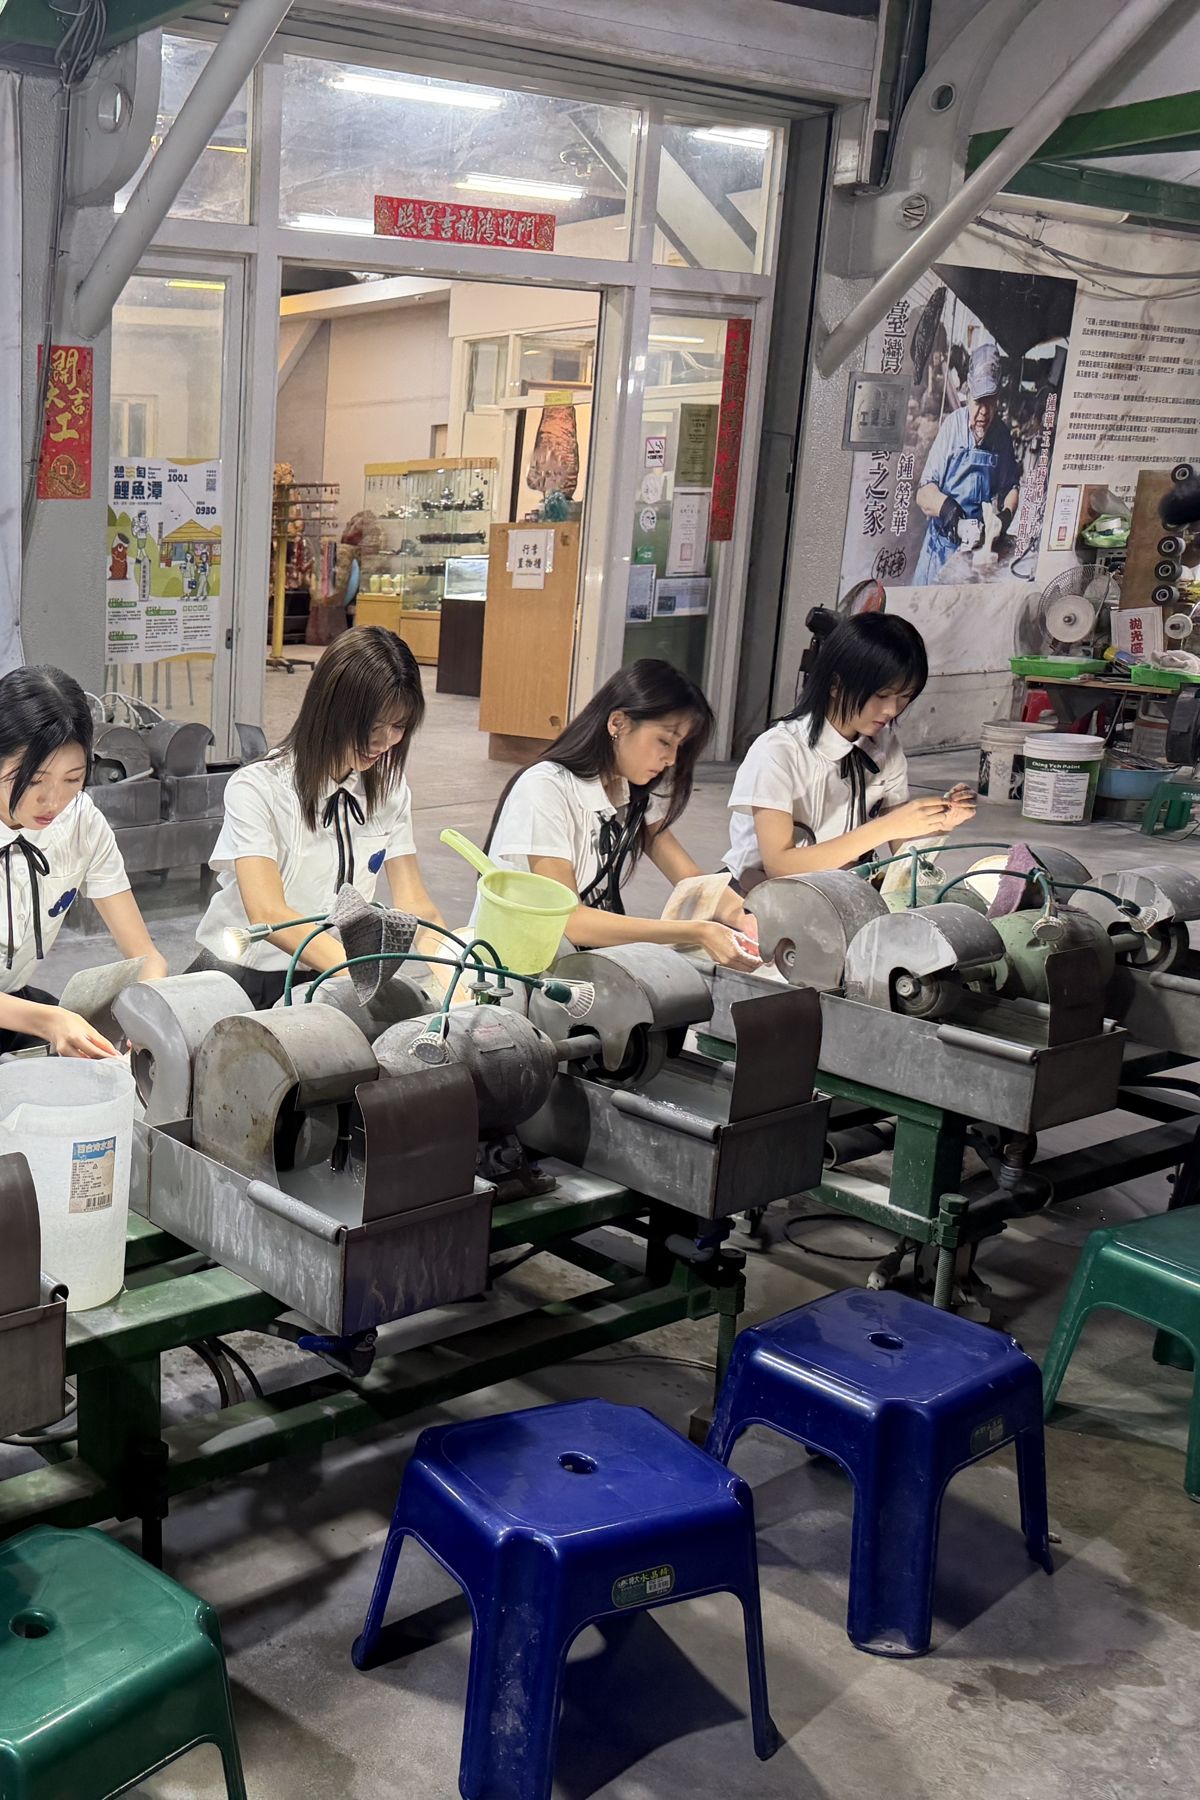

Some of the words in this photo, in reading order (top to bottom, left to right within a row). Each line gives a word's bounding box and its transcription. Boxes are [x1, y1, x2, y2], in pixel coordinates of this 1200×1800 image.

[167, 474, 188, 482] 1001
[113, 480, 162, 500] 鯉魚潭
[195, 506, 217, 515] 0930
